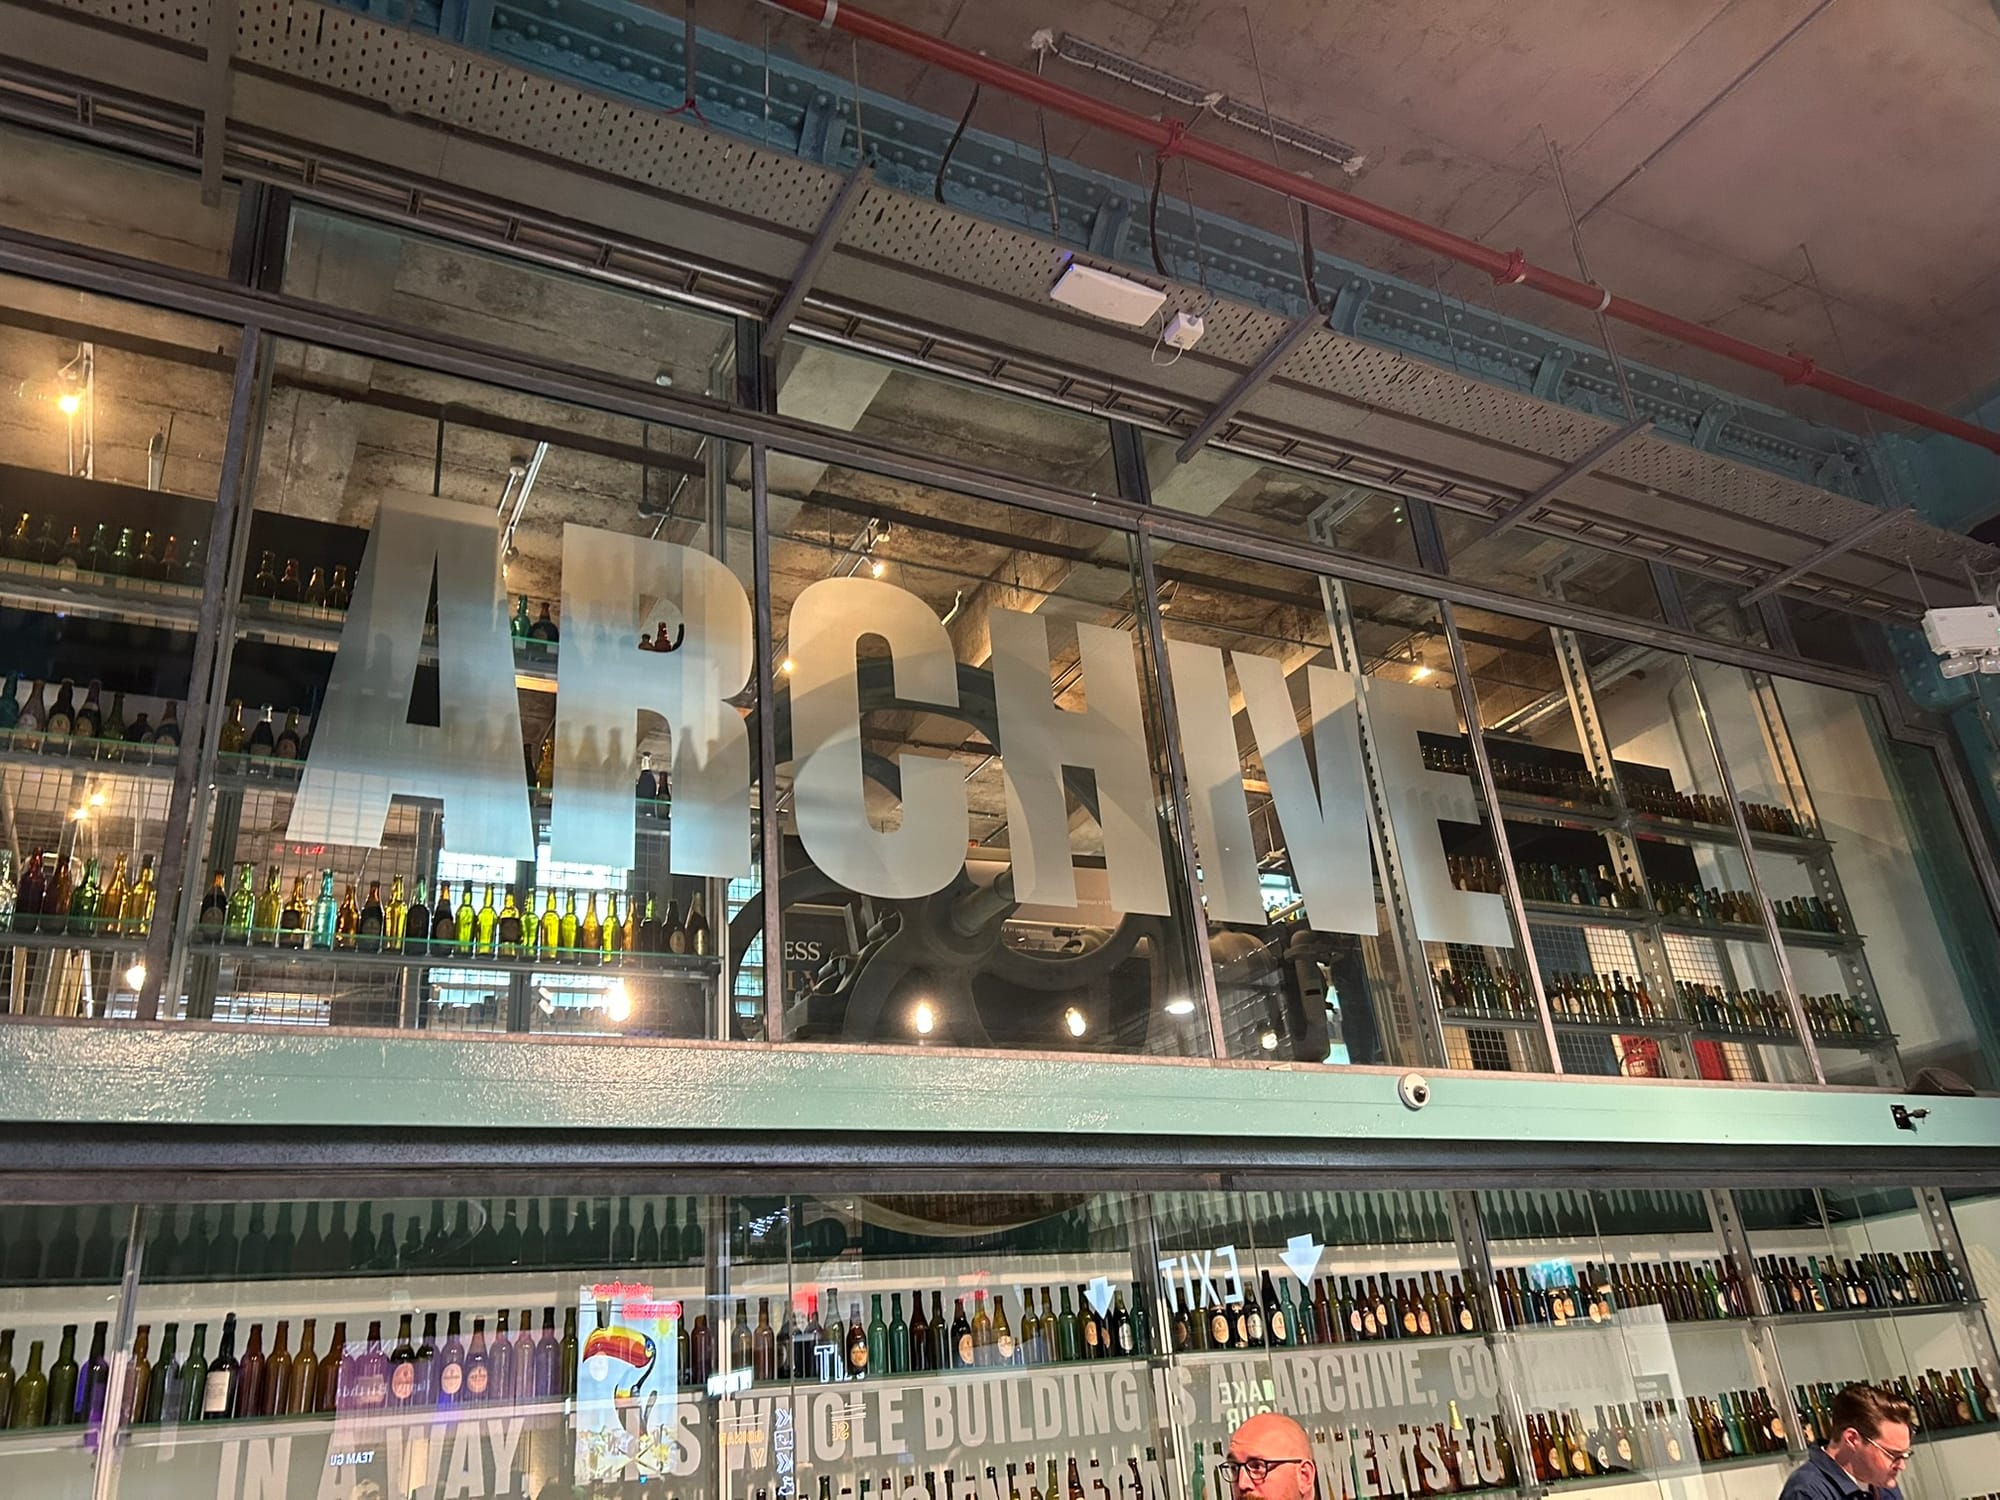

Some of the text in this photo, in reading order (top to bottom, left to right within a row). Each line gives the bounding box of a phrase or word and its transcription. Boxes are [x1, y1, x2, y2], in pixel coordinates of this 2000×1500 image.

[285, 493, 1515, 948] ARCHIVE
[386, 1417, 526, 1500] WAY
[922, 1369, 1142, 1451] BUILDING
[1152, 1365, 1197, 1429] IS
[1273, 1349, 1438, 1415] ARCHIVE,
[1451, 1427, 1501, 1486] TO
